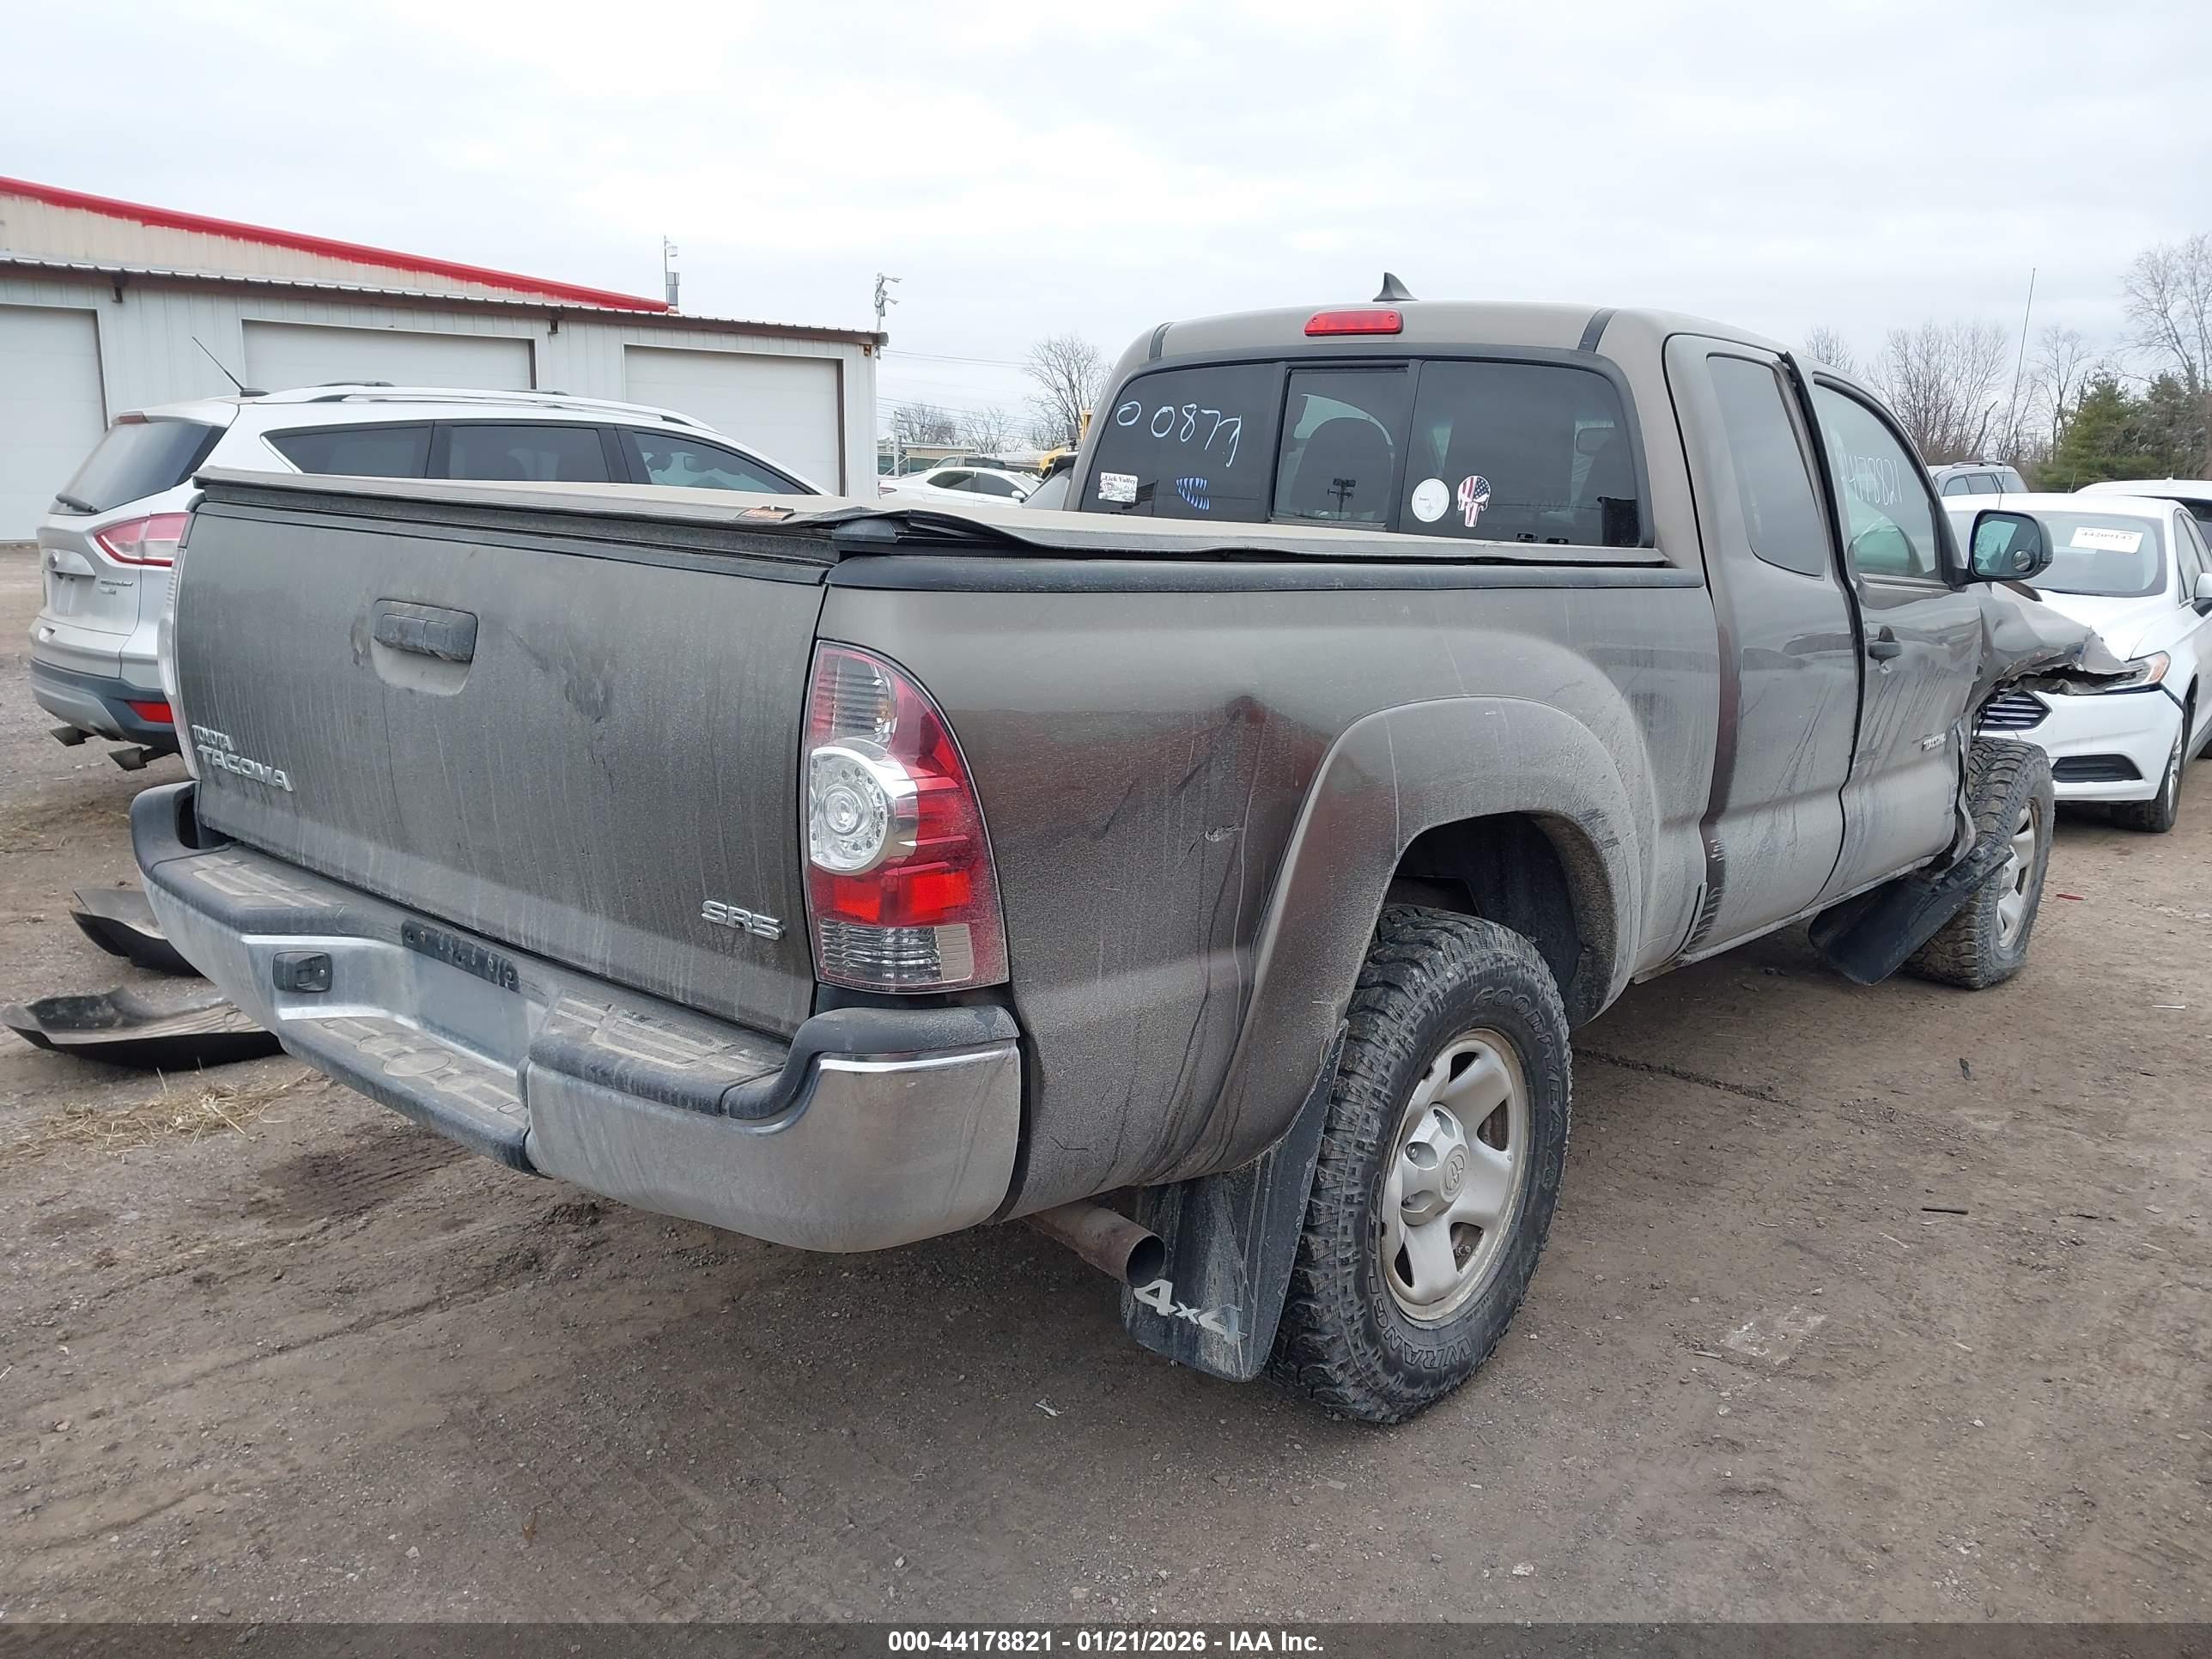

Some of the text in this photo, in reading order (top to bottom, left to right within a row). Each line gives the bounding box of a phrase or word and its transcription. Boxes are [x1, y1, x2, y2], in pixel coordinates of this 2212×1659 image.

[191, 724, 234, 752] TOYOTA
[196, 744, 294, 793] TACOMA
[701, 899, 784, 942] SR5
